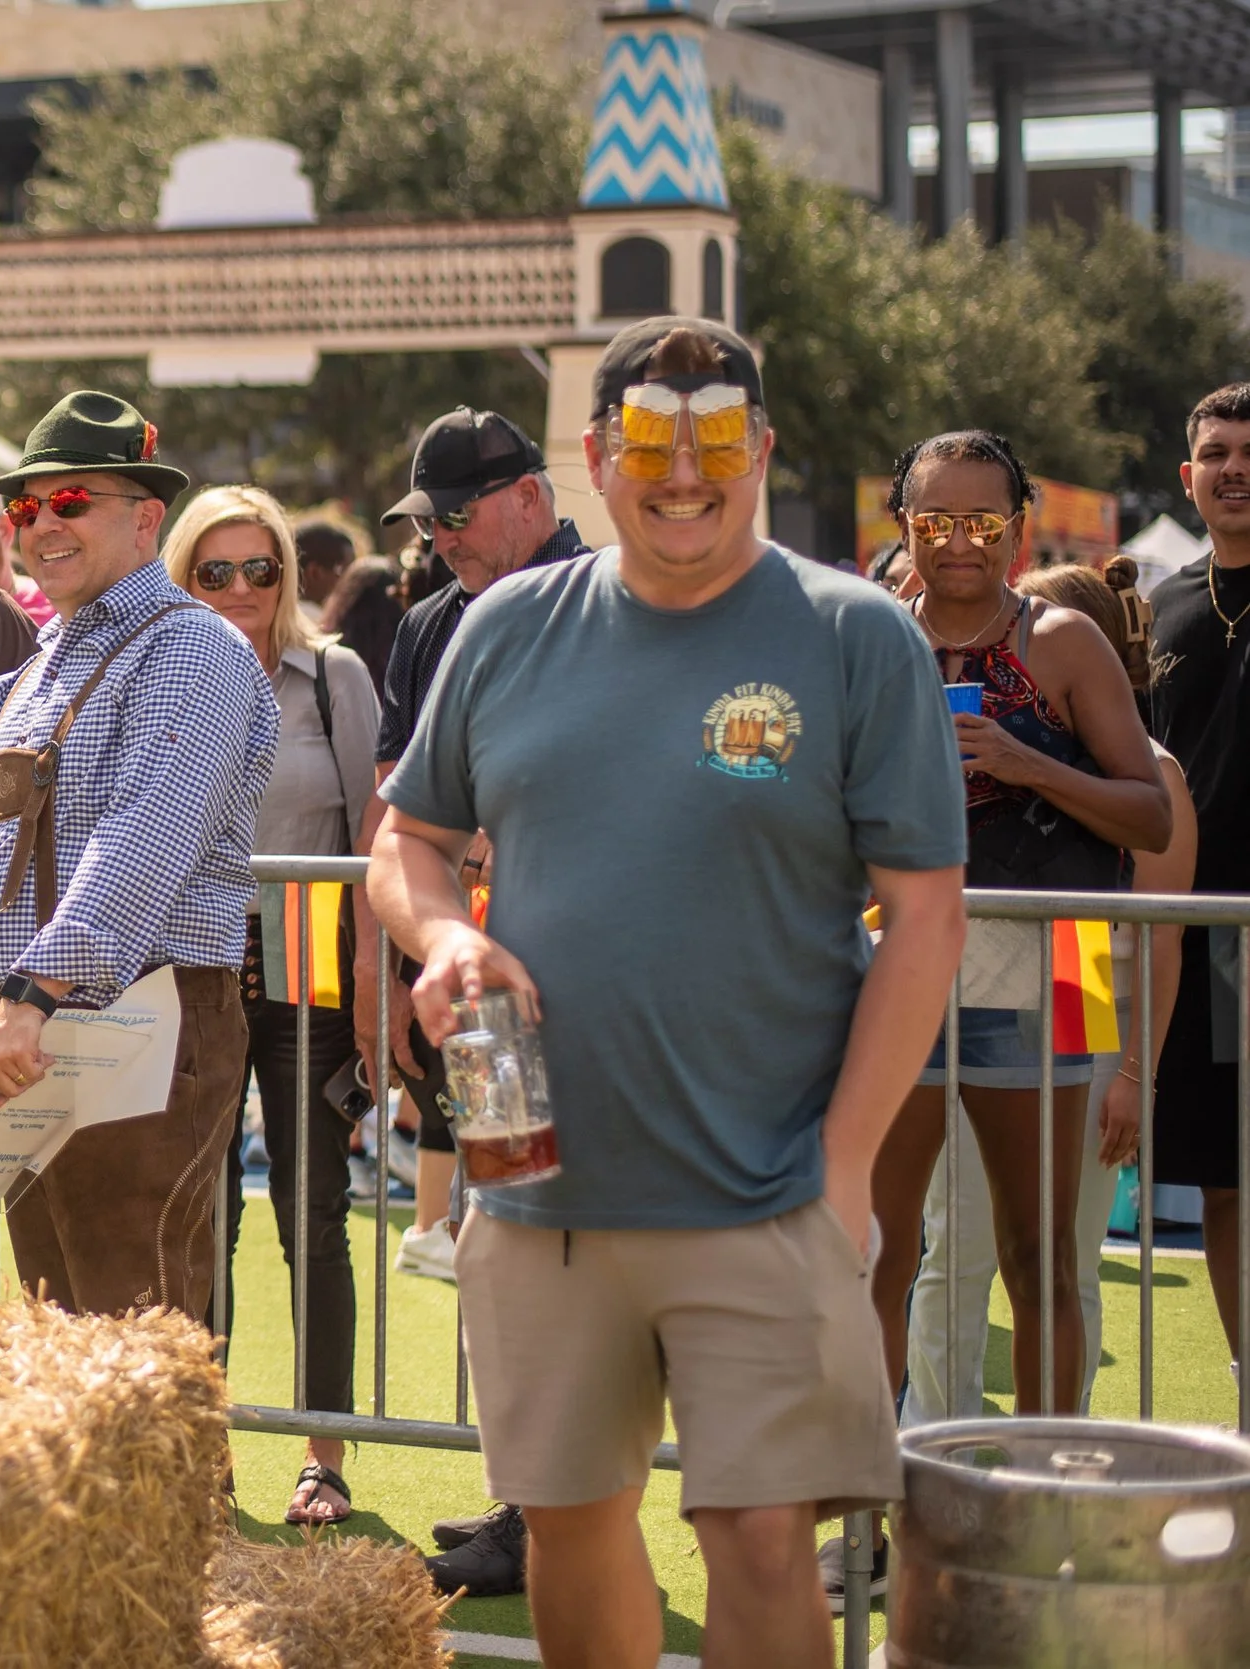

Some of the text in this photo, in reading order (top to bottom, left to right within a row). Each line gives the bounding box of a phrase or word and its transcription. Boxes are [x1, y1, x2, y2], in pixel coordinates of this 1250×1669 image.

[702, 693, 734, 725] KINDA
[734, 682, 757, 698] FIT
[759, 683, 797, 711] KINDA
